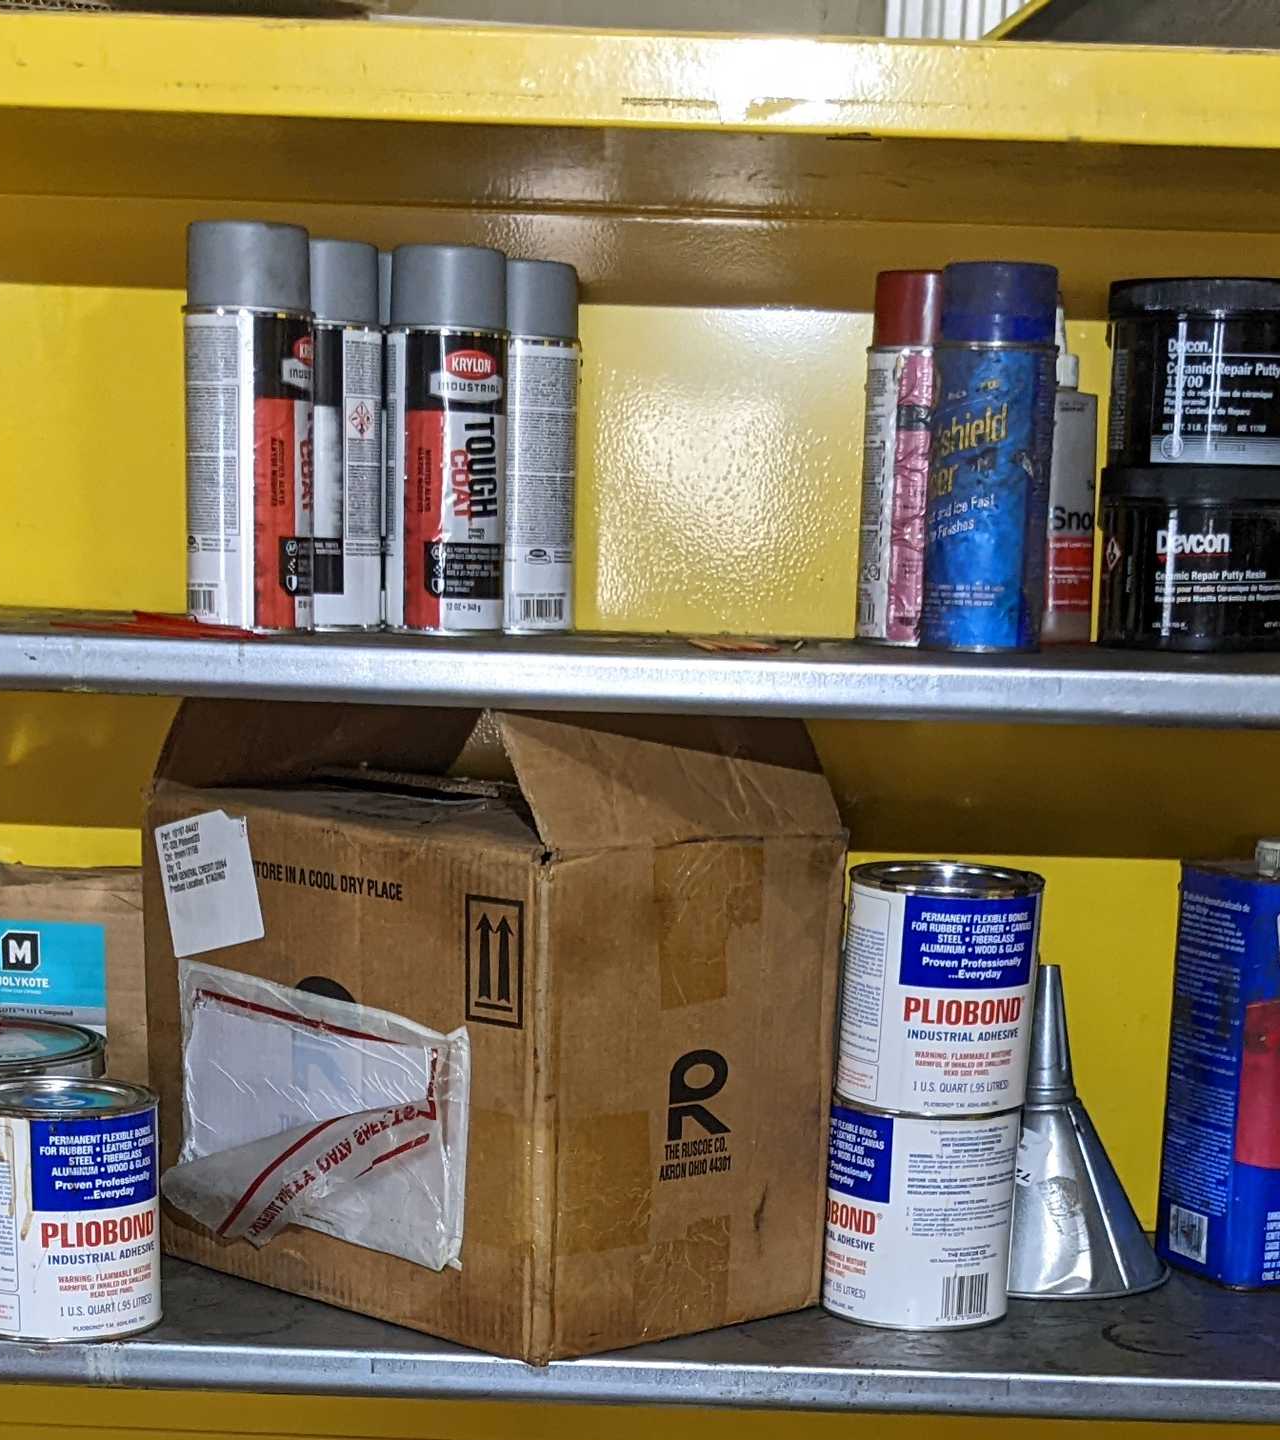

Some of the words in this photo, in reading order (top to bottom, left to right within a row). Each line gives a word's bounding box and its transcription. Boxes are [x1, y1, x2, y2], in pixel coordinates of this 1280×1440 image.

[451, 356, 492, 373] KRYLON
[1216, 361, 1253, 378] Repair
[438, 382, 499, 394] INDUSTRIAL
[464, 416, 498, 518] TOUGH
[450, 449, 474, 528] COAT
[1156, 529, 1231, 554] Devcon
[1155, 570, 1190, 581] Ceramic
[1191, 571, 1219, 583] Repair
[1221, 571, 1244, 582] Putty
[1245, 570, 1267, 580] Resin
[254, 860, 283, 881] TORE
[285, 865, 297, 883] IN
[299, 868, 306, 885] A
[309, 869, 337, 891] COOL
[340, 875, 365, 895] DRY
[367, 878, 404, 901] PLACE
[921, 911, 972, 923] PERMANENT
[974, 913, 1007, 923] FLEXIBLE
[911, 921, 927, 931] FOR
[929, 923, 963, 933] RUBBER
[972, 924, 1004, 934] LEATHER
[937, 934, 962, 944] STEEL
[971, 934, 1015, 944] FIBERGLASS
[8, 939, 31, 964] M
[920, 944, 965, 954] ALUMINUM
[975, 944, 997, 954] WOOD
[1005, 943, 1024, 953] GLASS
[922, 956, 958, 967] Proven
[961, 957, 1022, 968] Professionally
[903, 996, 1021, 1025] PLIOBOND
[907, 1029, 974, 1042] INDUSTRIAL
[977, 1027, 1018, 1041] ADHESIVE
[915, 1060, 942, 1068] HARMFUL
[951, 1052, 989, 1061] FLAMMABLE
[667, 1049, 732, 1141] R
[940, 1083, 968, 1093] QUART
[49, 1134, 101, 1145] PERMANENT
[103, 1129, 134, 1143] FLEXIBLE
[861, 1137, 885, 1150] CANVAS
[40, 1146, 57, 1155] FOR
[59, 1145, 93, 1155] RUBBER
[102, 1141, 132, 1153] LEATHER
[664, 1142, 680, 1160] THE
[681, 1138, 713, 1158] RUSCOE
[714, 1135, 727, 1153] CO.
[69, 1156, 94, 1166] STEEL
[103, 1149, 142, 1163] FIBERGLASS
[857, 1155, 875, 1168] GLASS
[52, 1166, 98, 1177] ALUMINUM
[107, 1161, 128, 1173] WOOD
[135, 1156, 151, 1168] GLASS
[659, 1163, 687, 1182] AKRON
[688, 1159, 708, 1177] OHIO
[709, 1155, 732, 1173] 44301
[55, 1180, 92, 1190] Proven
[95, 1171, 151, 1188] Professionally
[41, 1210, 154, 1249] PLIOBOND
[837, 1234, 875, 1252] ADHESIVE
[48, 1251, 116, 1265] INDUSTRIAL
[119, 1240, 155, 1260] ADHESIVE
[96, 1268, 132, 1282] FLAMMABLE
[59, 1282, 88, 1292] HARMFUL
[68, 1305, 85, 1317] U.S.
[88, 1302, 115, 1316] QUART
